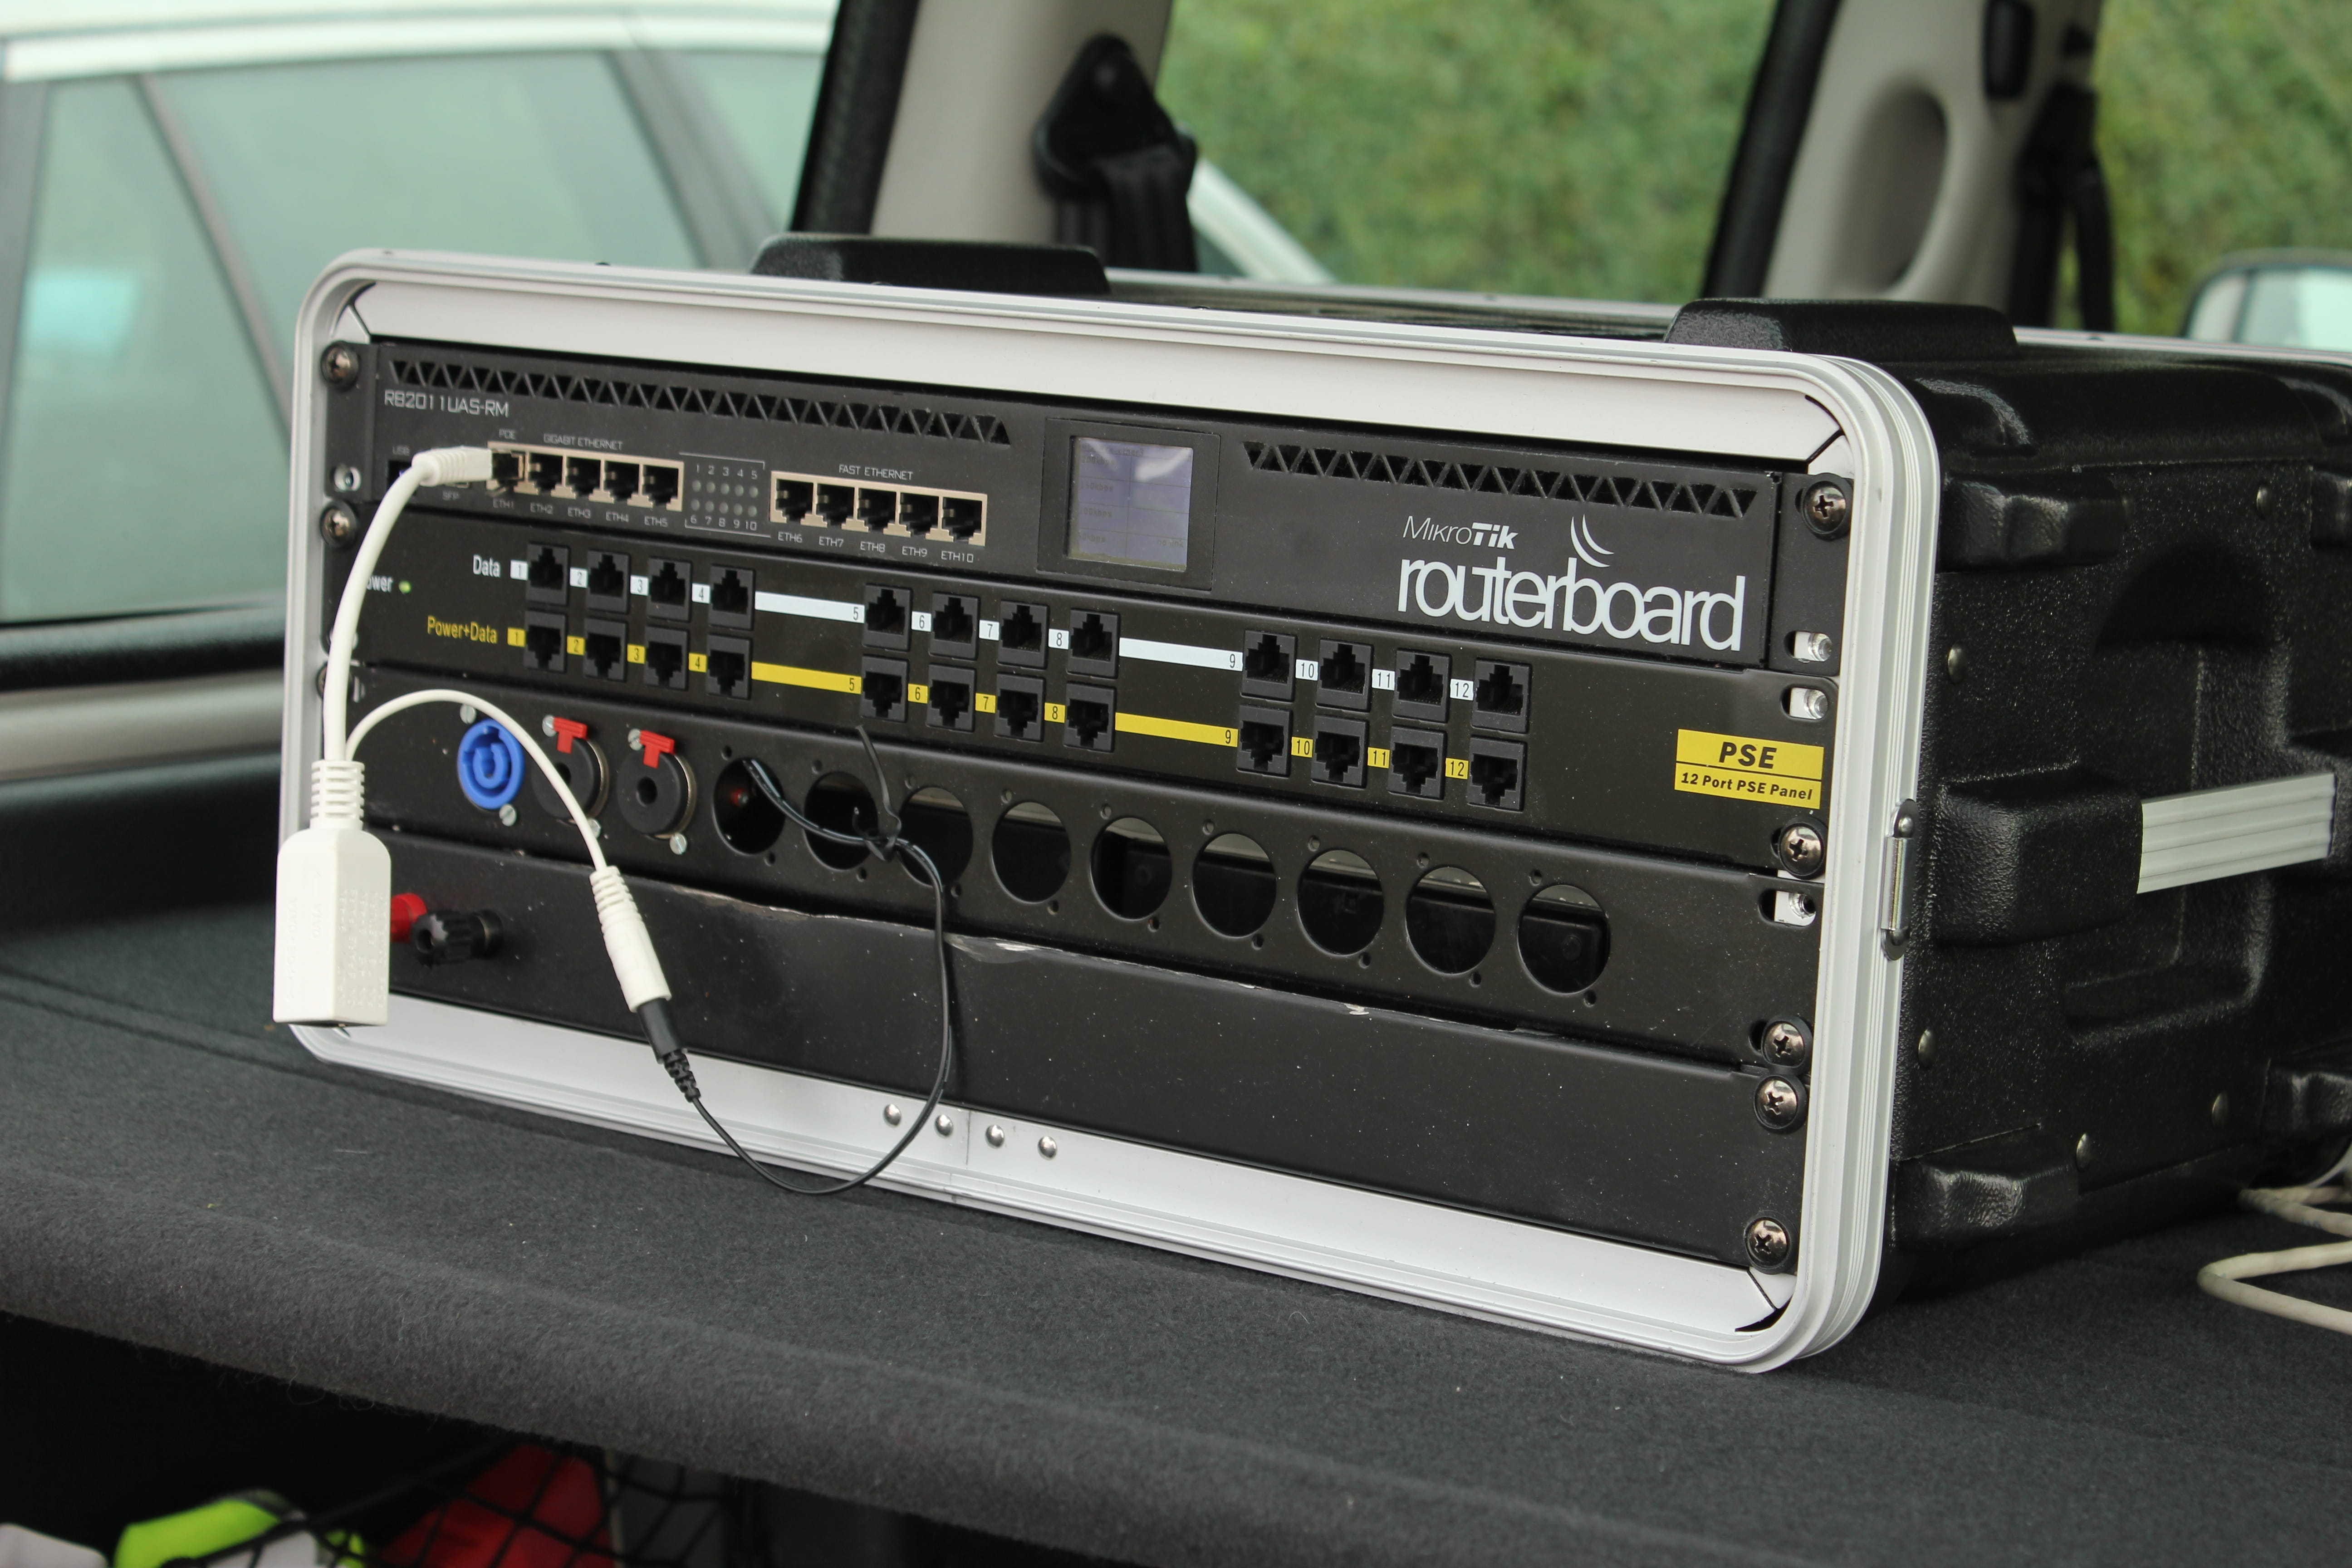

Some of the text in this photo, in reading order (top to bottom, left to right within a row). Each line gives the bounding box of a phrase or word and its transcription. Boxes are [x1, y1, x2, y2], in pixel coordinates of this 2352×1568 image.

[384, 390, 509, 417] RB2011UAS-RM
[544, 434, 623, 451] GIGABIT ETHERNET
[696, 465, 757, 480] 1 2 3 4 5
[838, 464, 914, 480] FAST ETHERNET
[529, 503, 553, 514] ETH2
[568, 507, 591, 519] ETH3
[606, 511, 629, 523] ETH4
[644, 515, 668, 527] ETH5
[691, 514, 757, 531] 6 7 8 9 10
[1402, 515, 1519, 550] MikroTik
[778, 531, 974, 563] ETH6 ETH7 ETH8 ETH9 ETH10
[366, 575, 393, 593] ower
[1397, 556, 1746, 652] routerboard
[473, 554, 1470, 698] Data 1 2 3 4 5 6 7 8 9 10 11 12
[427, 615, 1464, 777] Power+Data 1 2 3 4 5 6 7 8 9 10 11 12
[1719, 741, 1777, 769] PSE
[1681, 772, 1813, 800] 12 Port PSE Panel
